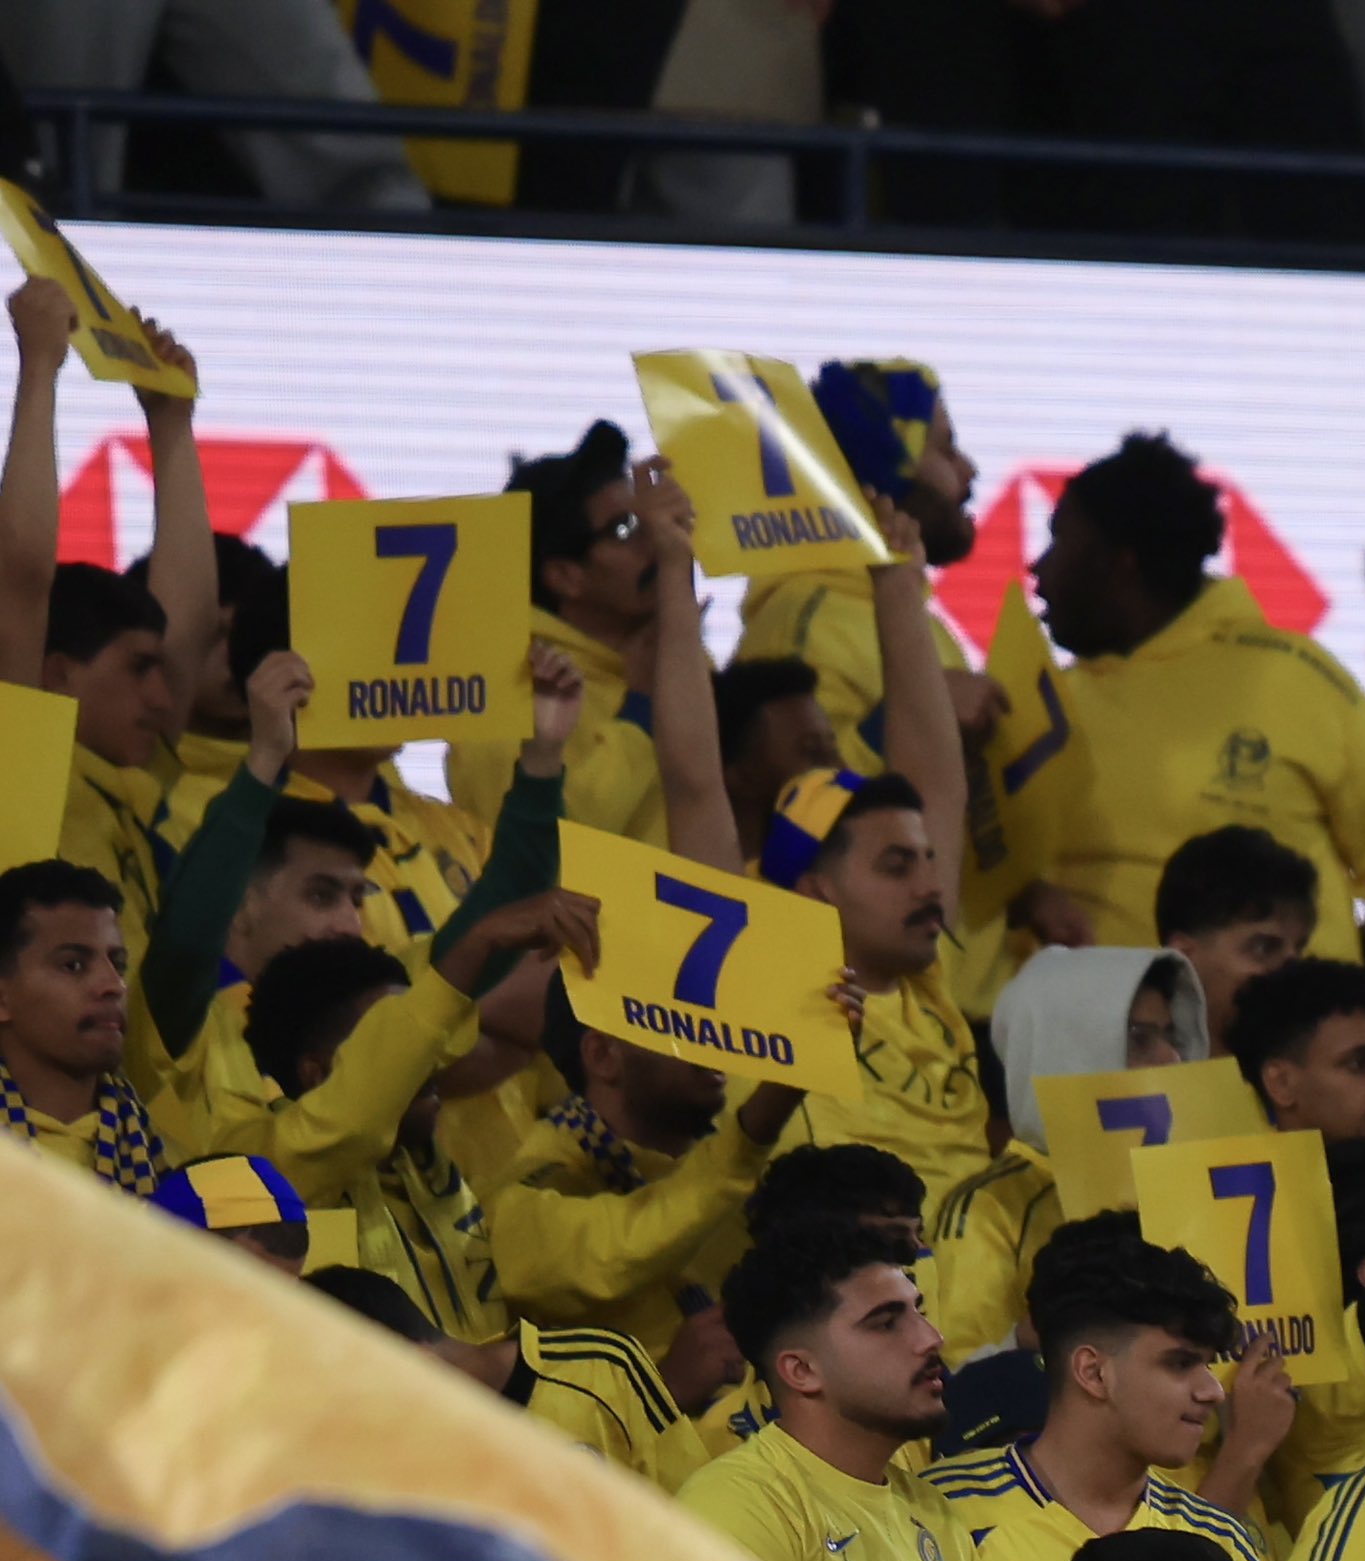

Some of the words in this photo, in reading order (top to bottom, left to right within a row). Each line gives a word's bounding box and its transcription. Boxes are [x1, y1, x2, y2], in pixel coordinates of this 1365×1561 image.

[712, 373, 796, 497] 7
[377, 525, 457, 665] 7
[352, 678, 486, 718] RONALDO
[657, 875, 749, 1008] 7
[622, 998, 794, 1066] RONALDO
[1212, 1164, 1276, 1306] 7
